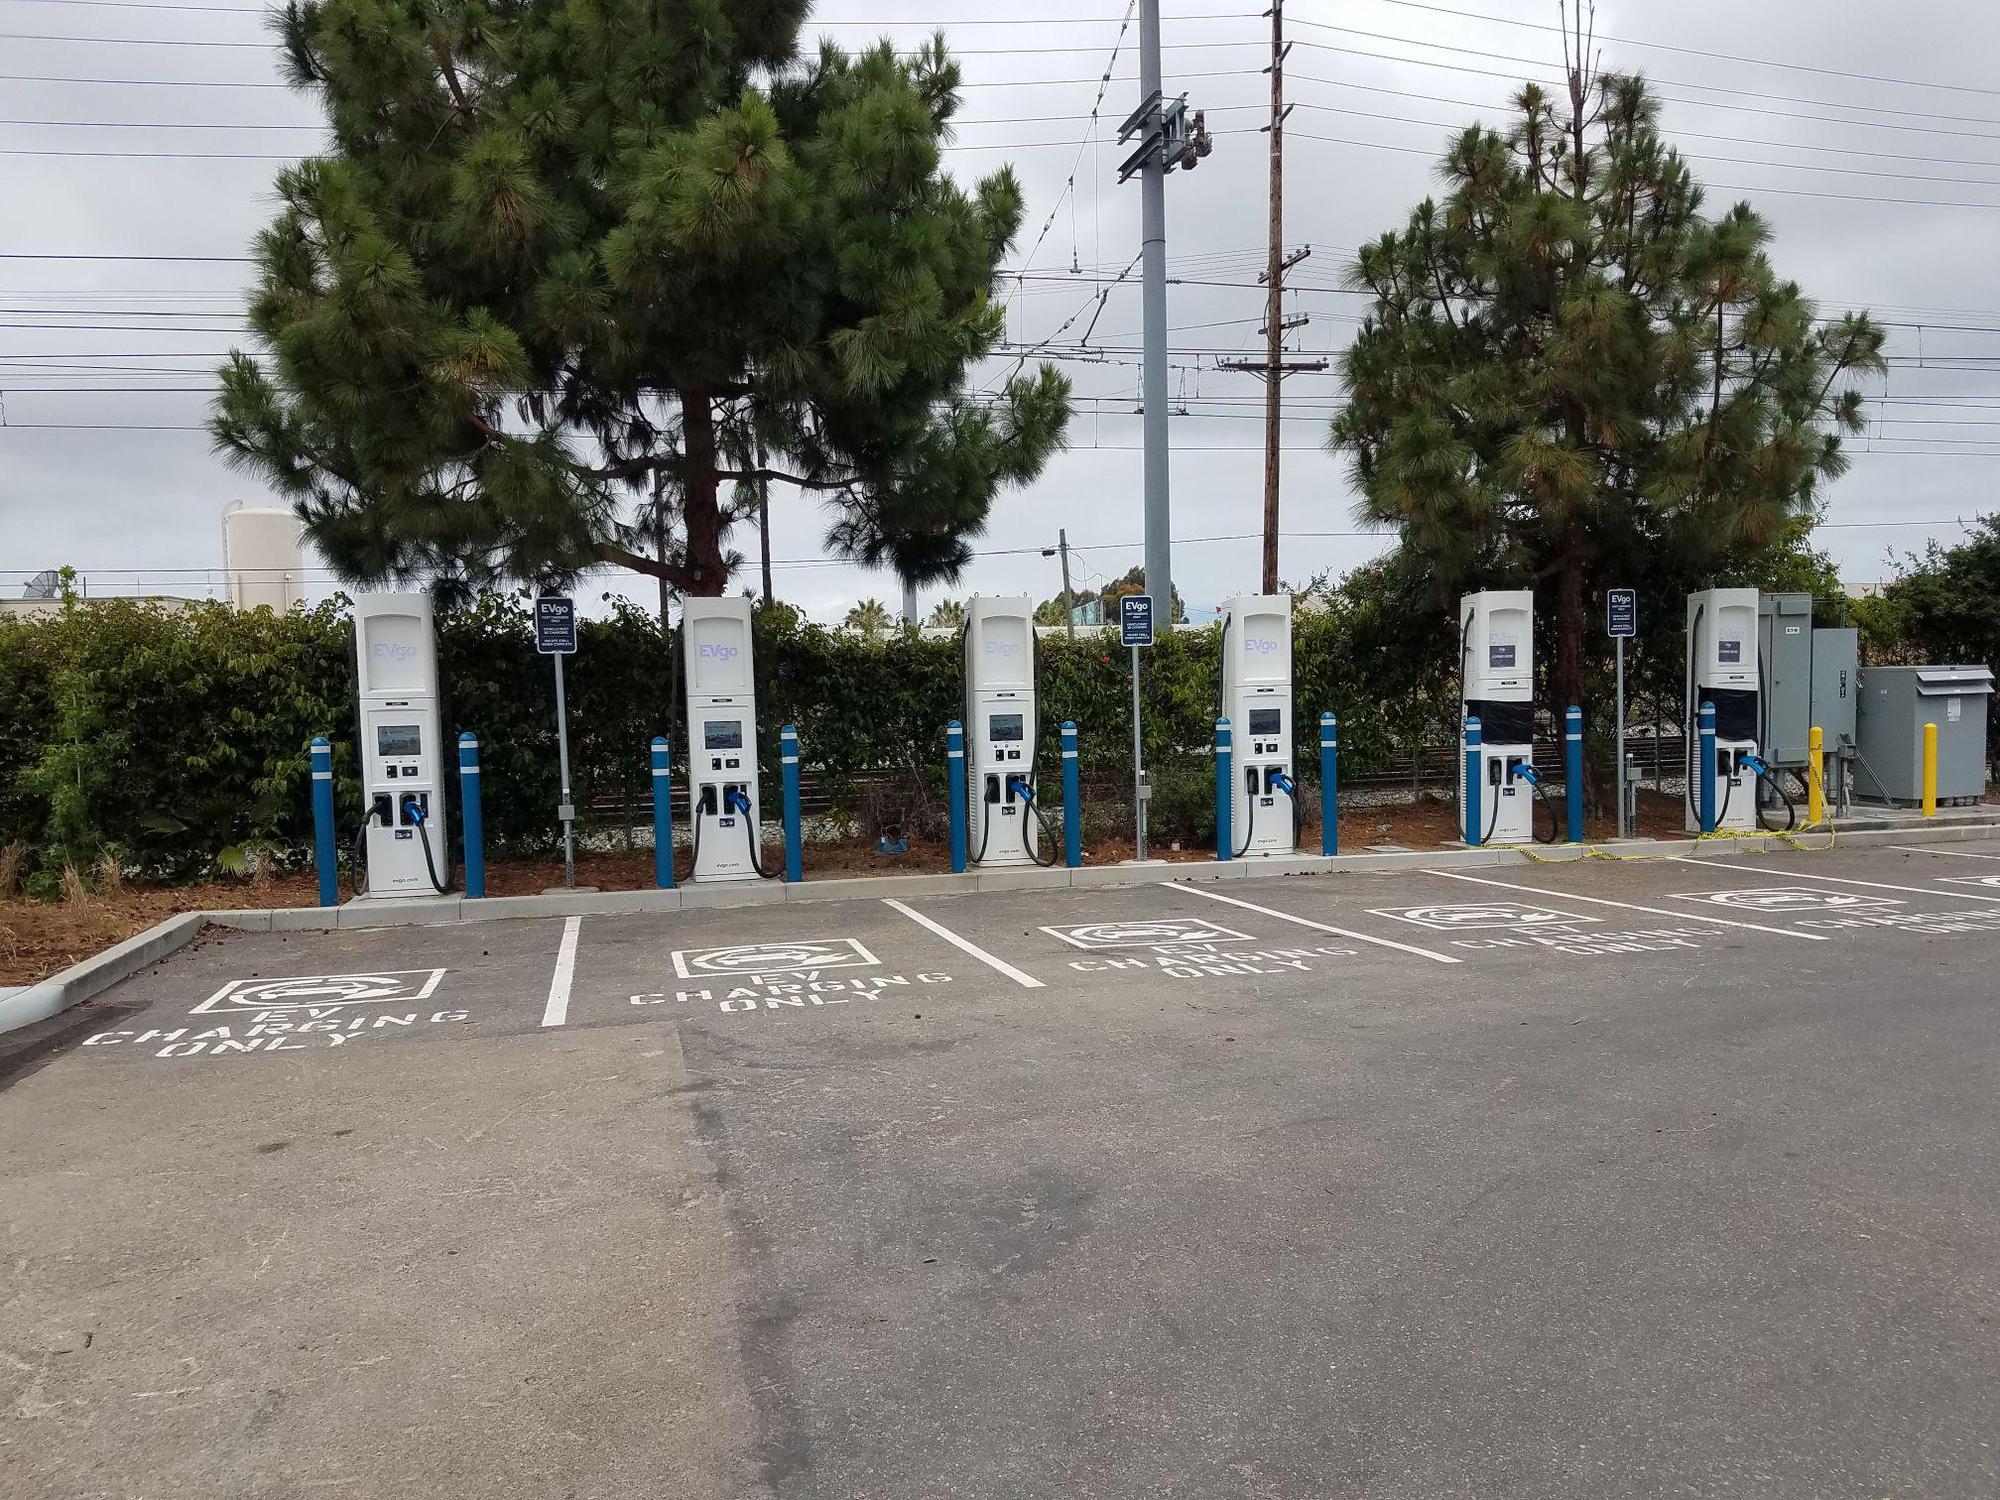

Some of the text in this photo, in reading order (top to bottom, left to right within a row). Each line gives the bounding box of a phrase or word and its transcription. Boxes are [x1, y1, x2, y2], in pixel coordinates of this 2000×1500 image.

[1125, 601, 1148, 612] EVgo
[1611, 594, 1631, 604] EVgo
[541, 603, 569, 616] EVgo
[373, 643, 417, 660] EVgo
[700, 644, 738, 660] EVgo
[1245, 640, 1278, 654] EVgo
[1151, 943, 1218, 955] EV
[1067, 946, 1359, 971] CHARGING
[750, 970, 820, 985] EV
[1161, 960, 1313, 978] ONLY
[629, 972, 953, 1006] CHARGING
[719, 989, 883, 1013] ONLY
[250, 1006, 344, 1023] EV
[81, 1010, 471, 1046] CHARGING
[154, 1031, 368, 1058] ONLY
